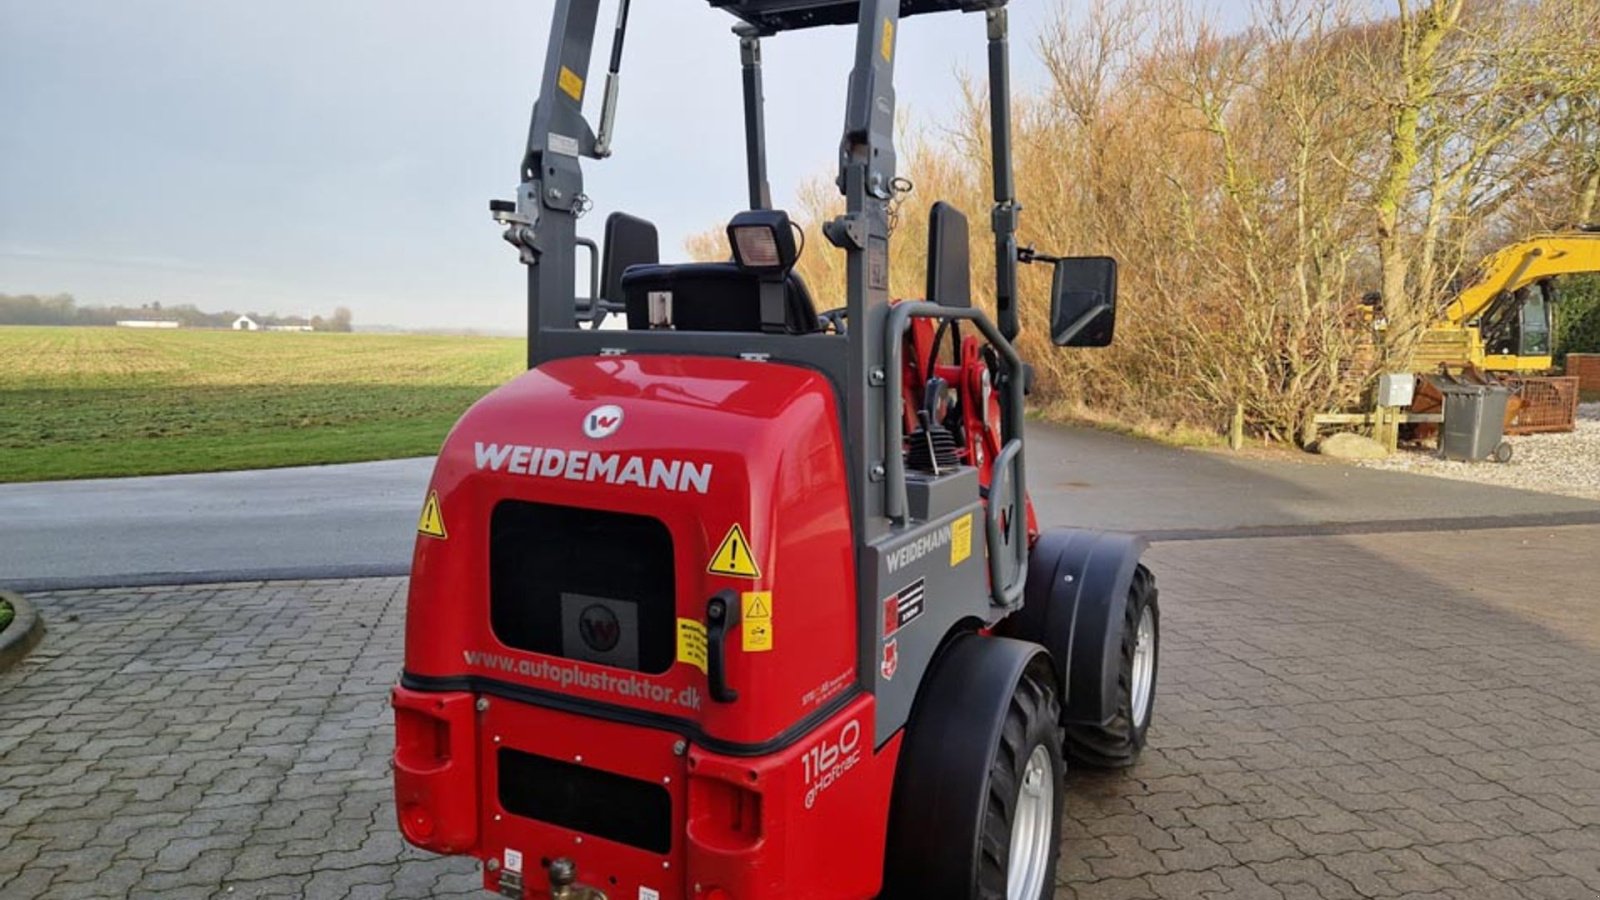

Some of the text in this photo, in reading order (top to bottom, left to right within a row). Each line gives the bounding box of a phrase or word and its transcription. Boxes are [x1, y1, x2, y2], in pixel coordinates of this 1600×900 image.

[474, 442, 713, 493] WEIDEMANN
[886, 525, 951, 574] WEIDEMANN
[463, 650, 701, 709] www.autoplustraktor.dk
[802, 719, 860, 784] 1160
